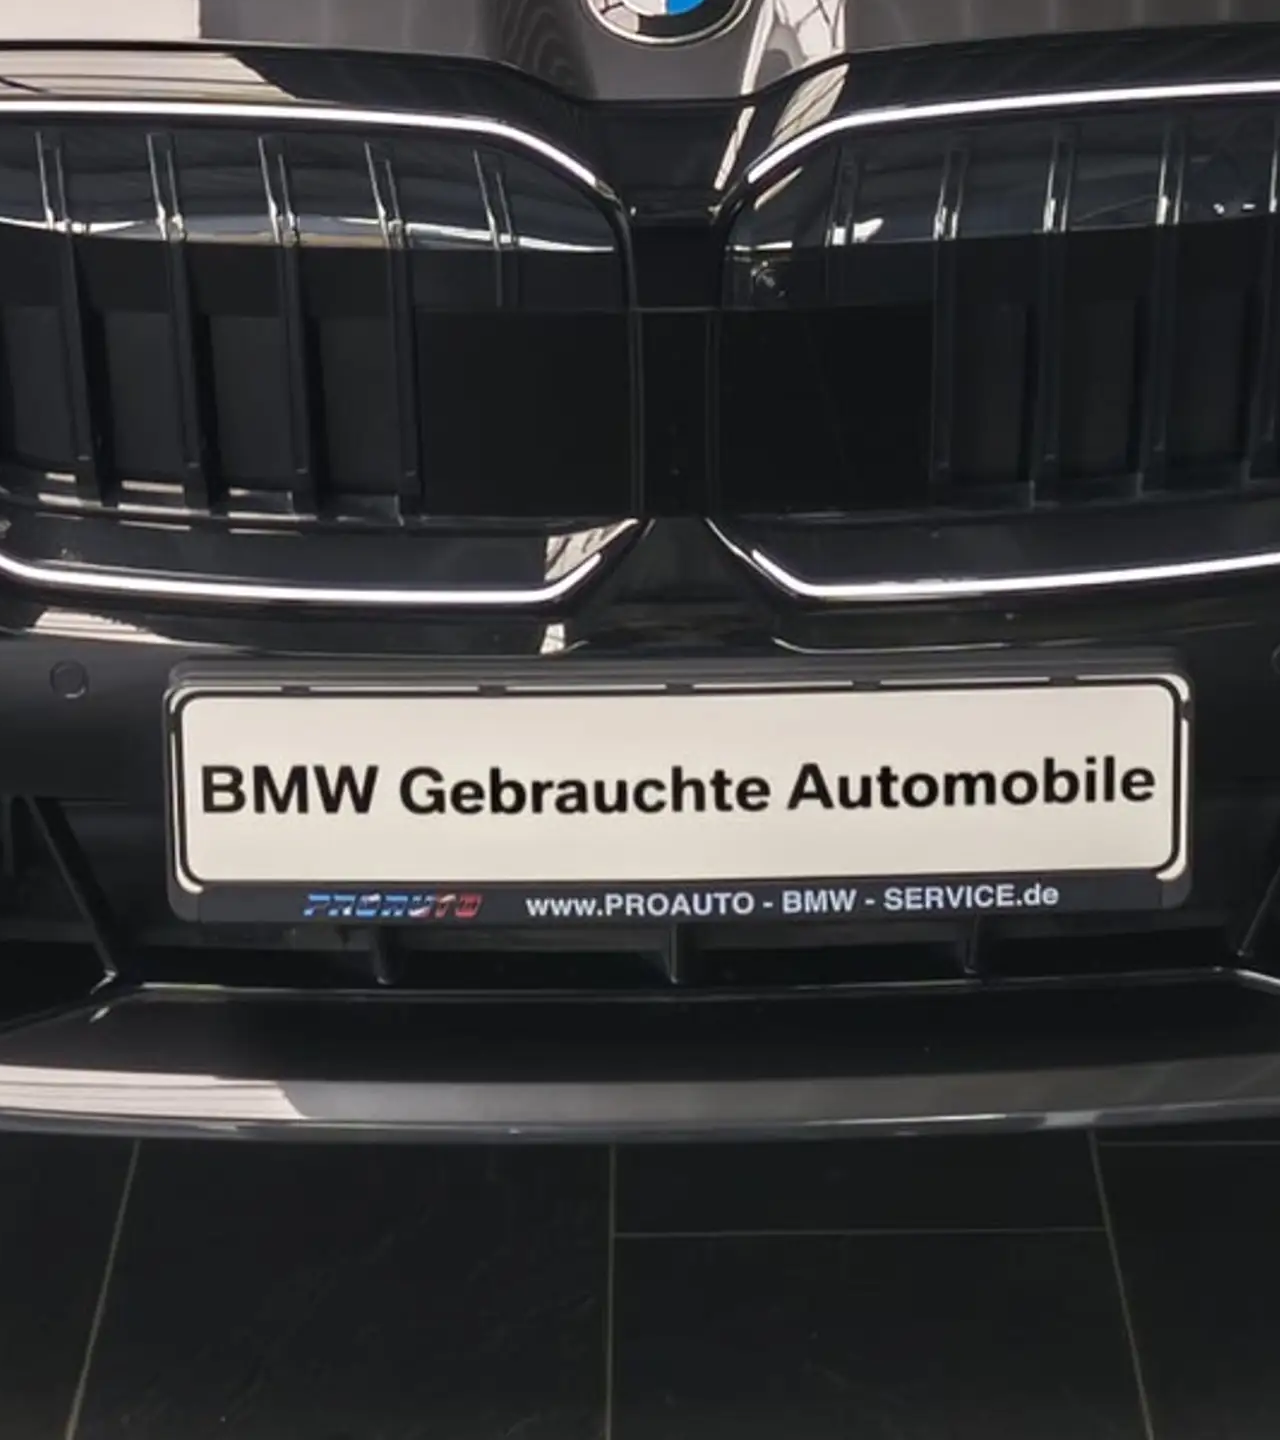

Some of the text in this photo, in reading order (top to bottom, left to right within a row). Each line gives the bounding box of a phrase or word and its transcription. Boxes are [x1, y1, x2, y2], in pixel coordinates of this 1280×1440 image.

[201, 754, 1157, 816] BMW Gebrauchte Automobile
[303, 892, 484, 919] PROAUTO
[525, 891, 755, 918] www.PROAUTO
[782, 889, 857, 914] BMW
[883, 882, 1060, 911] SERVICE.de
